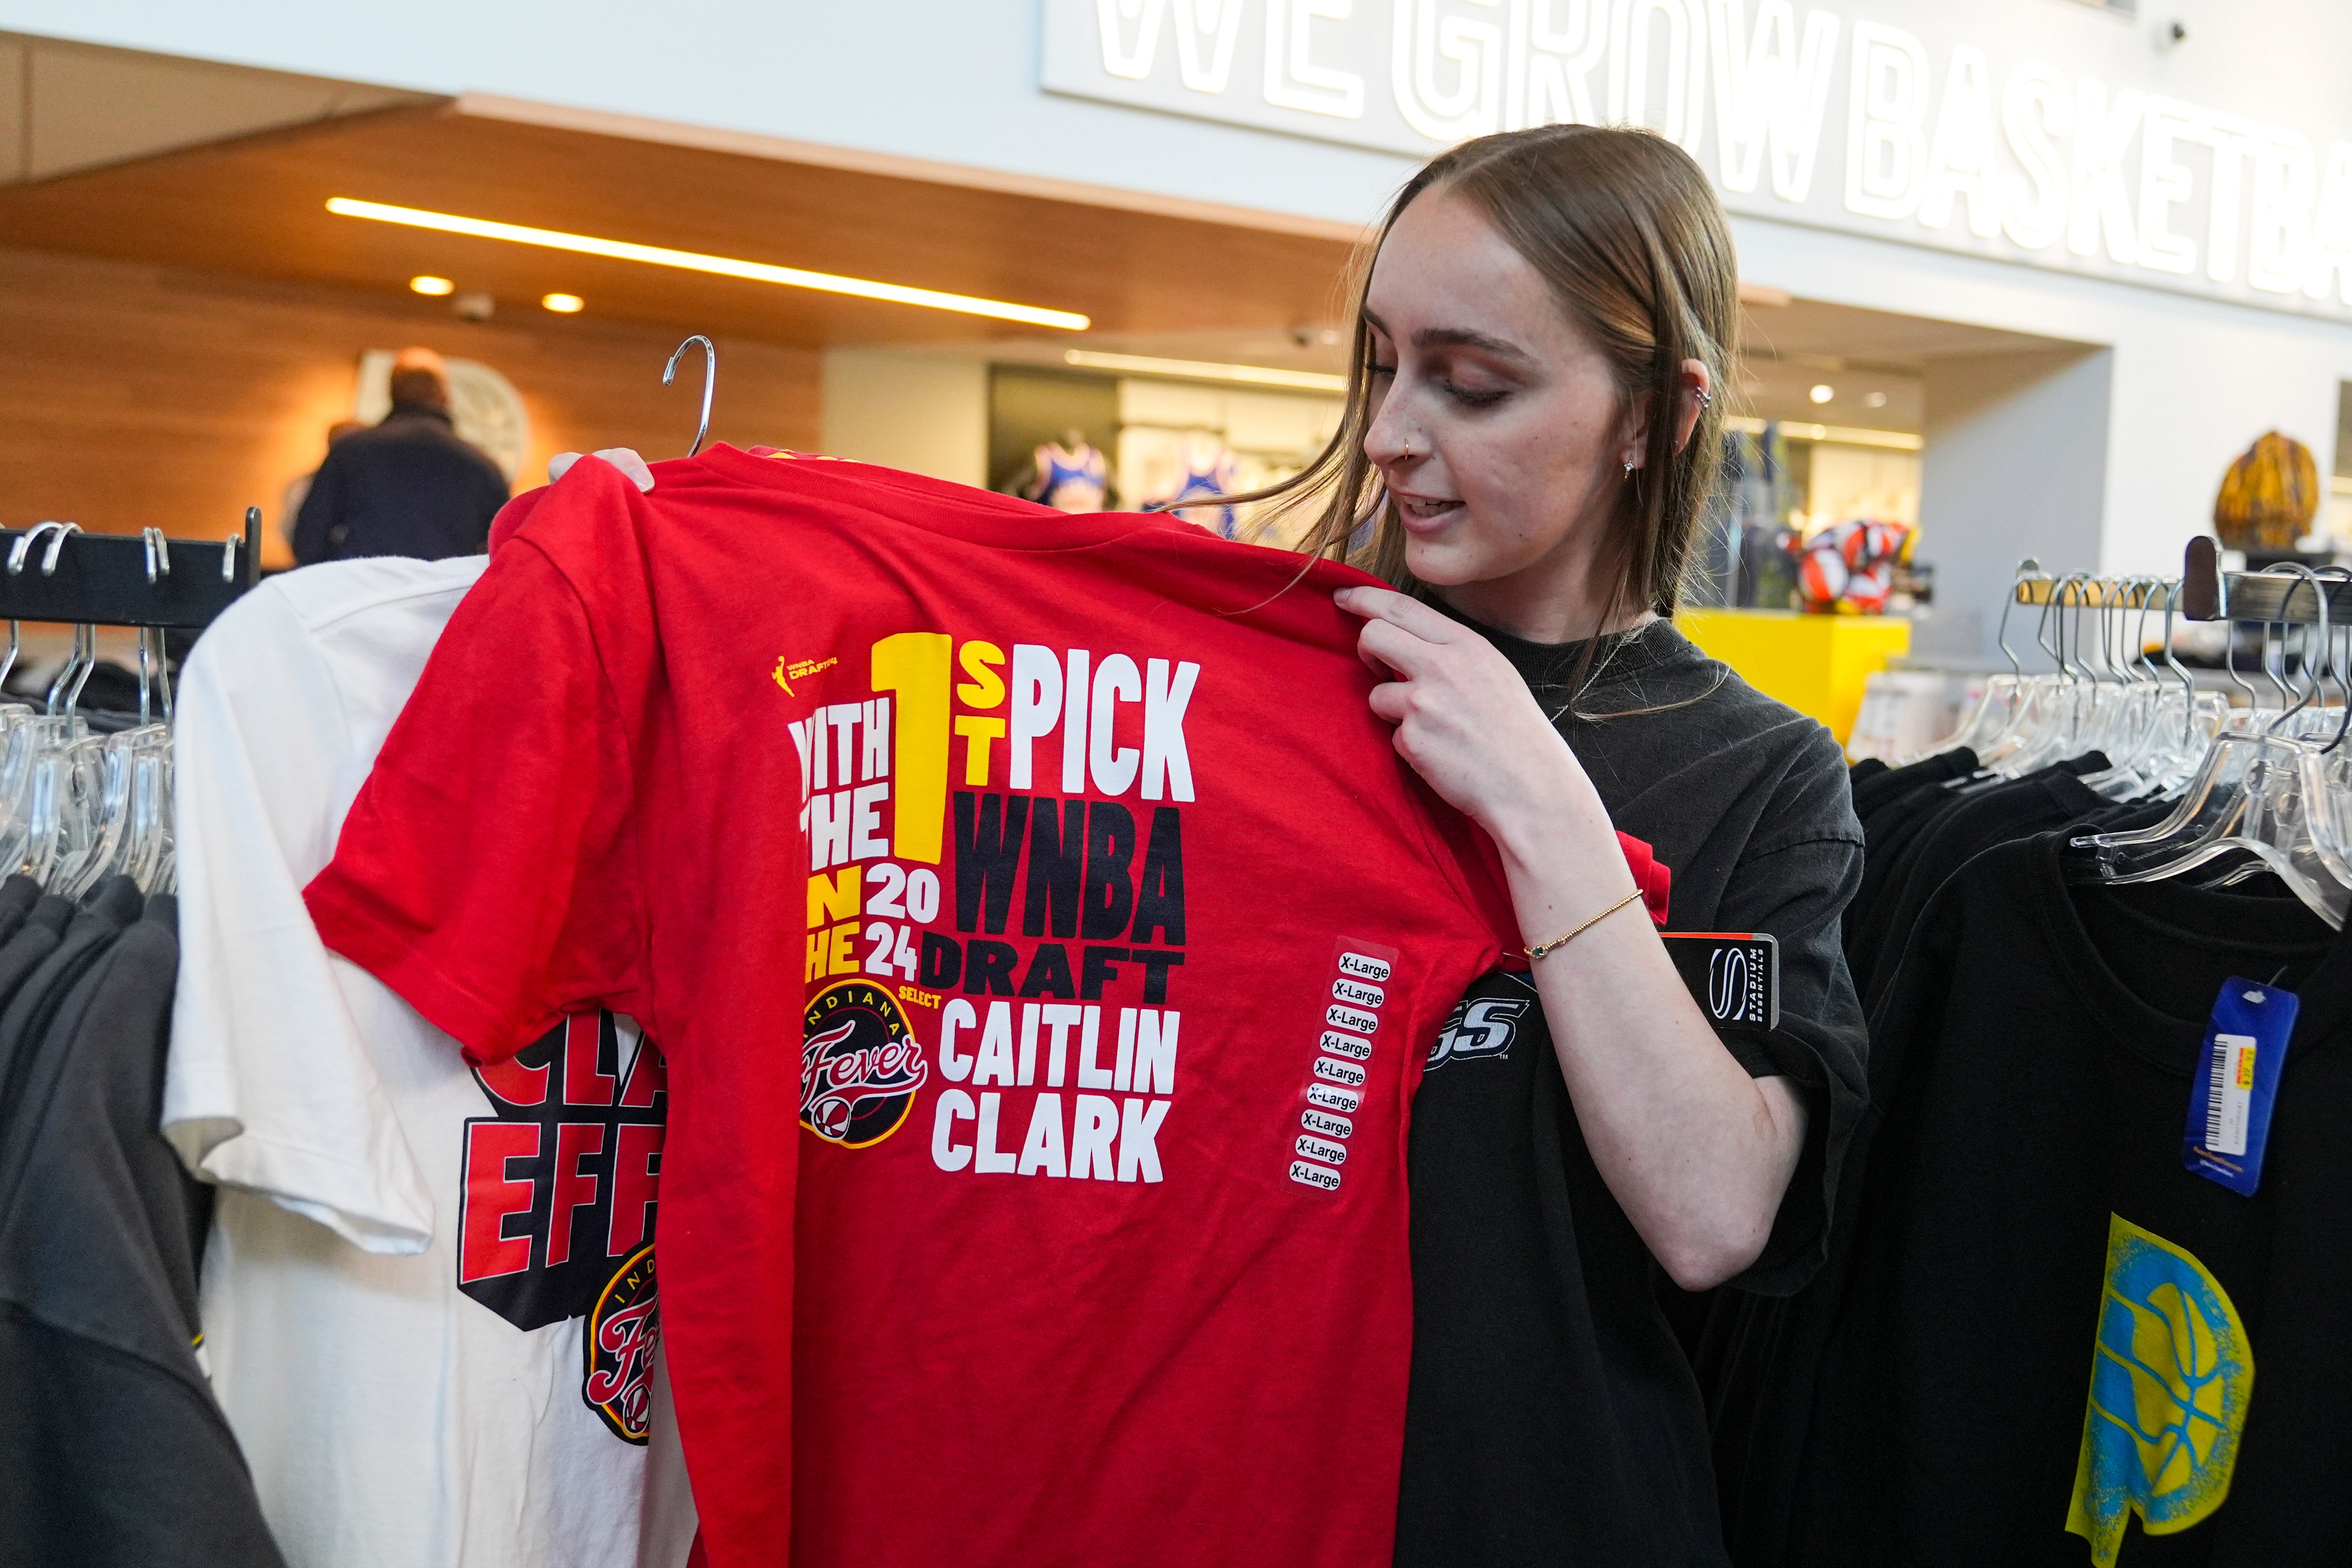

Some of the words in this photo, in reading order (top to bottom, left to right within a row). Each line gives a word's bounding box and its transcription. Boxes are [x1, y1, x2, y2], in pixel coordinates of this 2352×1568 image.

[787, 659, 815, 670] WNBA
[1010, 643, 1200, 803] PICK
[953, 791, 1186, 945] WNBA
[805, 921, 860, 983] HE
[919, 930, 1185, 1005] DRAFT
[1341, 956, 1389, 979] X-Large
[899, 985, 942, 1009] SELECT
[1334, 982, 1382, 1005] X-Large
[1328, 1009, 1377, 1031] X-Large
[939, 998, 1180, 1095] CAITLIN
[1322, 1035, 1370, 1058] X-Large
[800, 1020, 928, 1113] Fever
[1315, 1061, 1364, 1083] X-Large
[1309, 1087, 1357, 1109] X-Large
[931, 1089, 1171, 1183] CLARK
[1303, 1113, 1351, 1136] X-Large
[1297, 1138, 1345, 1162] X-Large
[1291, 1164, 1339, 1188] X-Large
